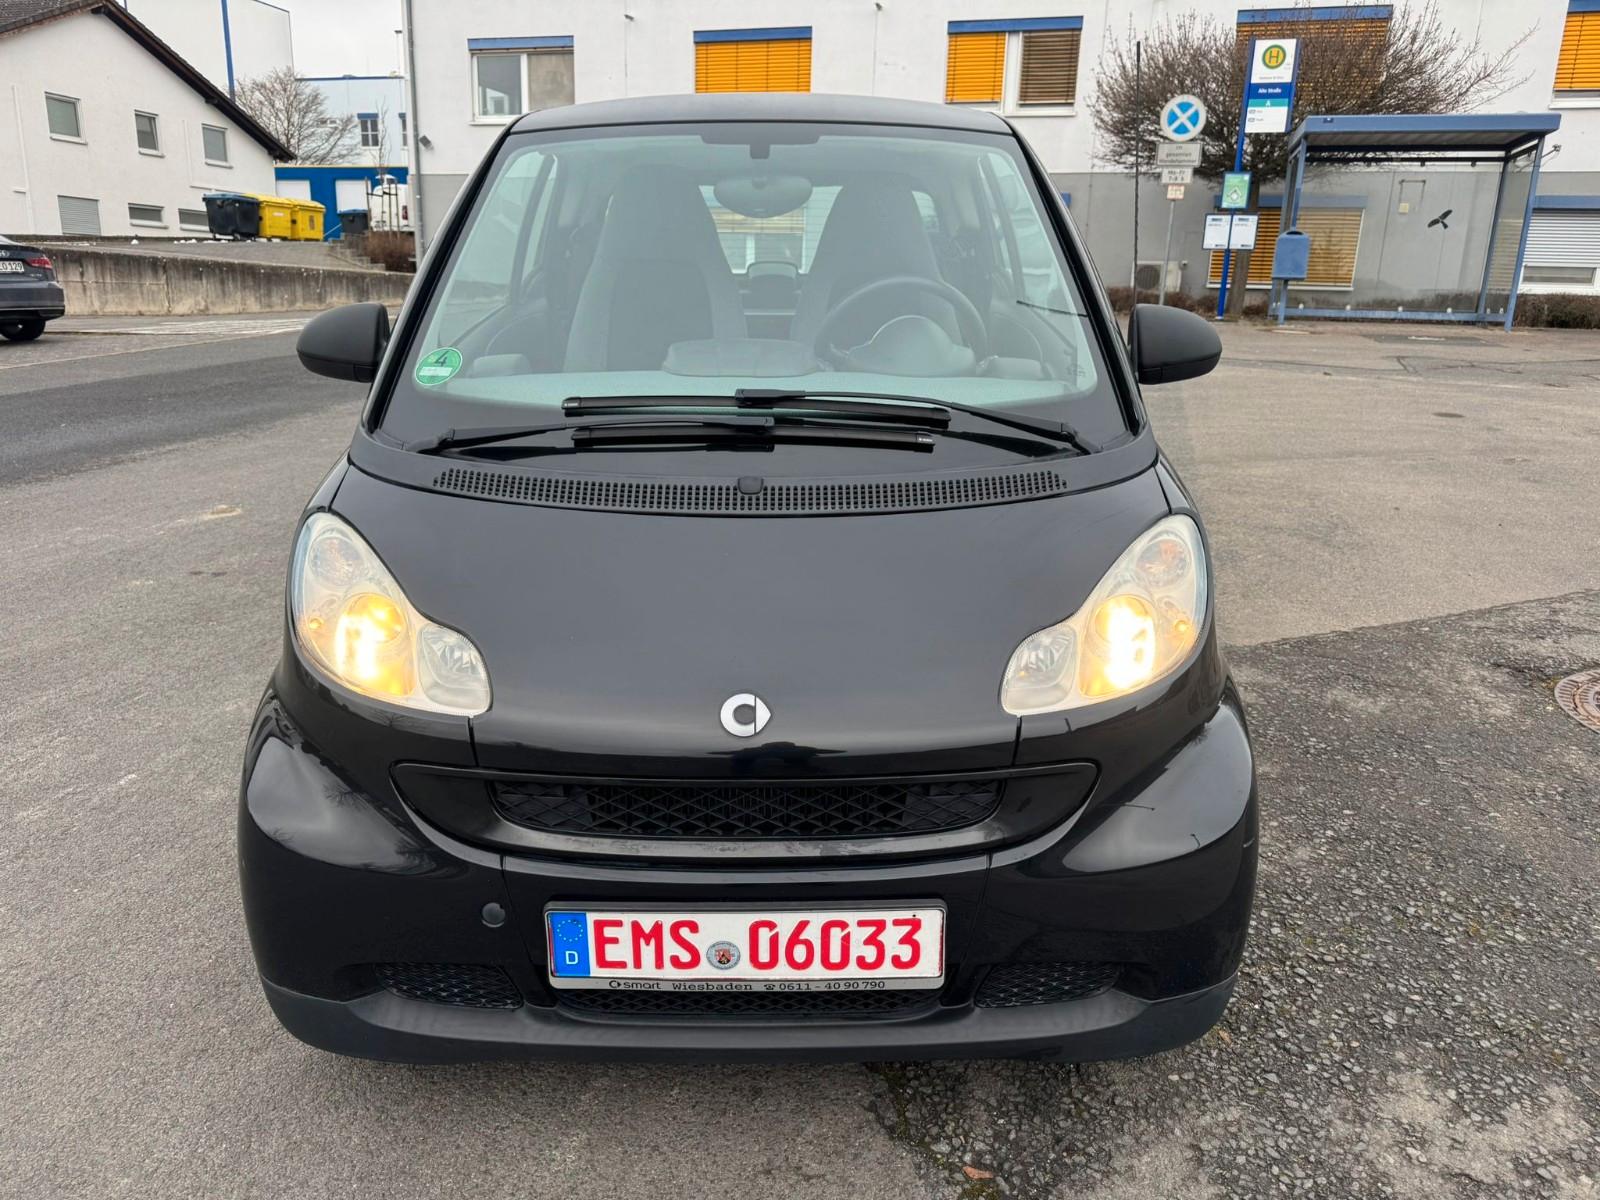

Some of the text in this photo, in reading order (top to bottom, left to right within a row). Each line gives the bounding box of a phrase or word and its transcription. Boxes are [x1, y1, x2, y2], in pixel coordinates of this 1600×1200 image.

[1268, 50, 1280, 64] H
[434, 350, 448, 367] 4
[593, 919, 701, 970] EMS
[748, 917, 922, 971] 06033
[565, 951, 578, 965] D
[623, 981, 661, 990] smart
[672, 982, 753, 991] Wiesbaden
[779, 982, 812, 991] 0611
